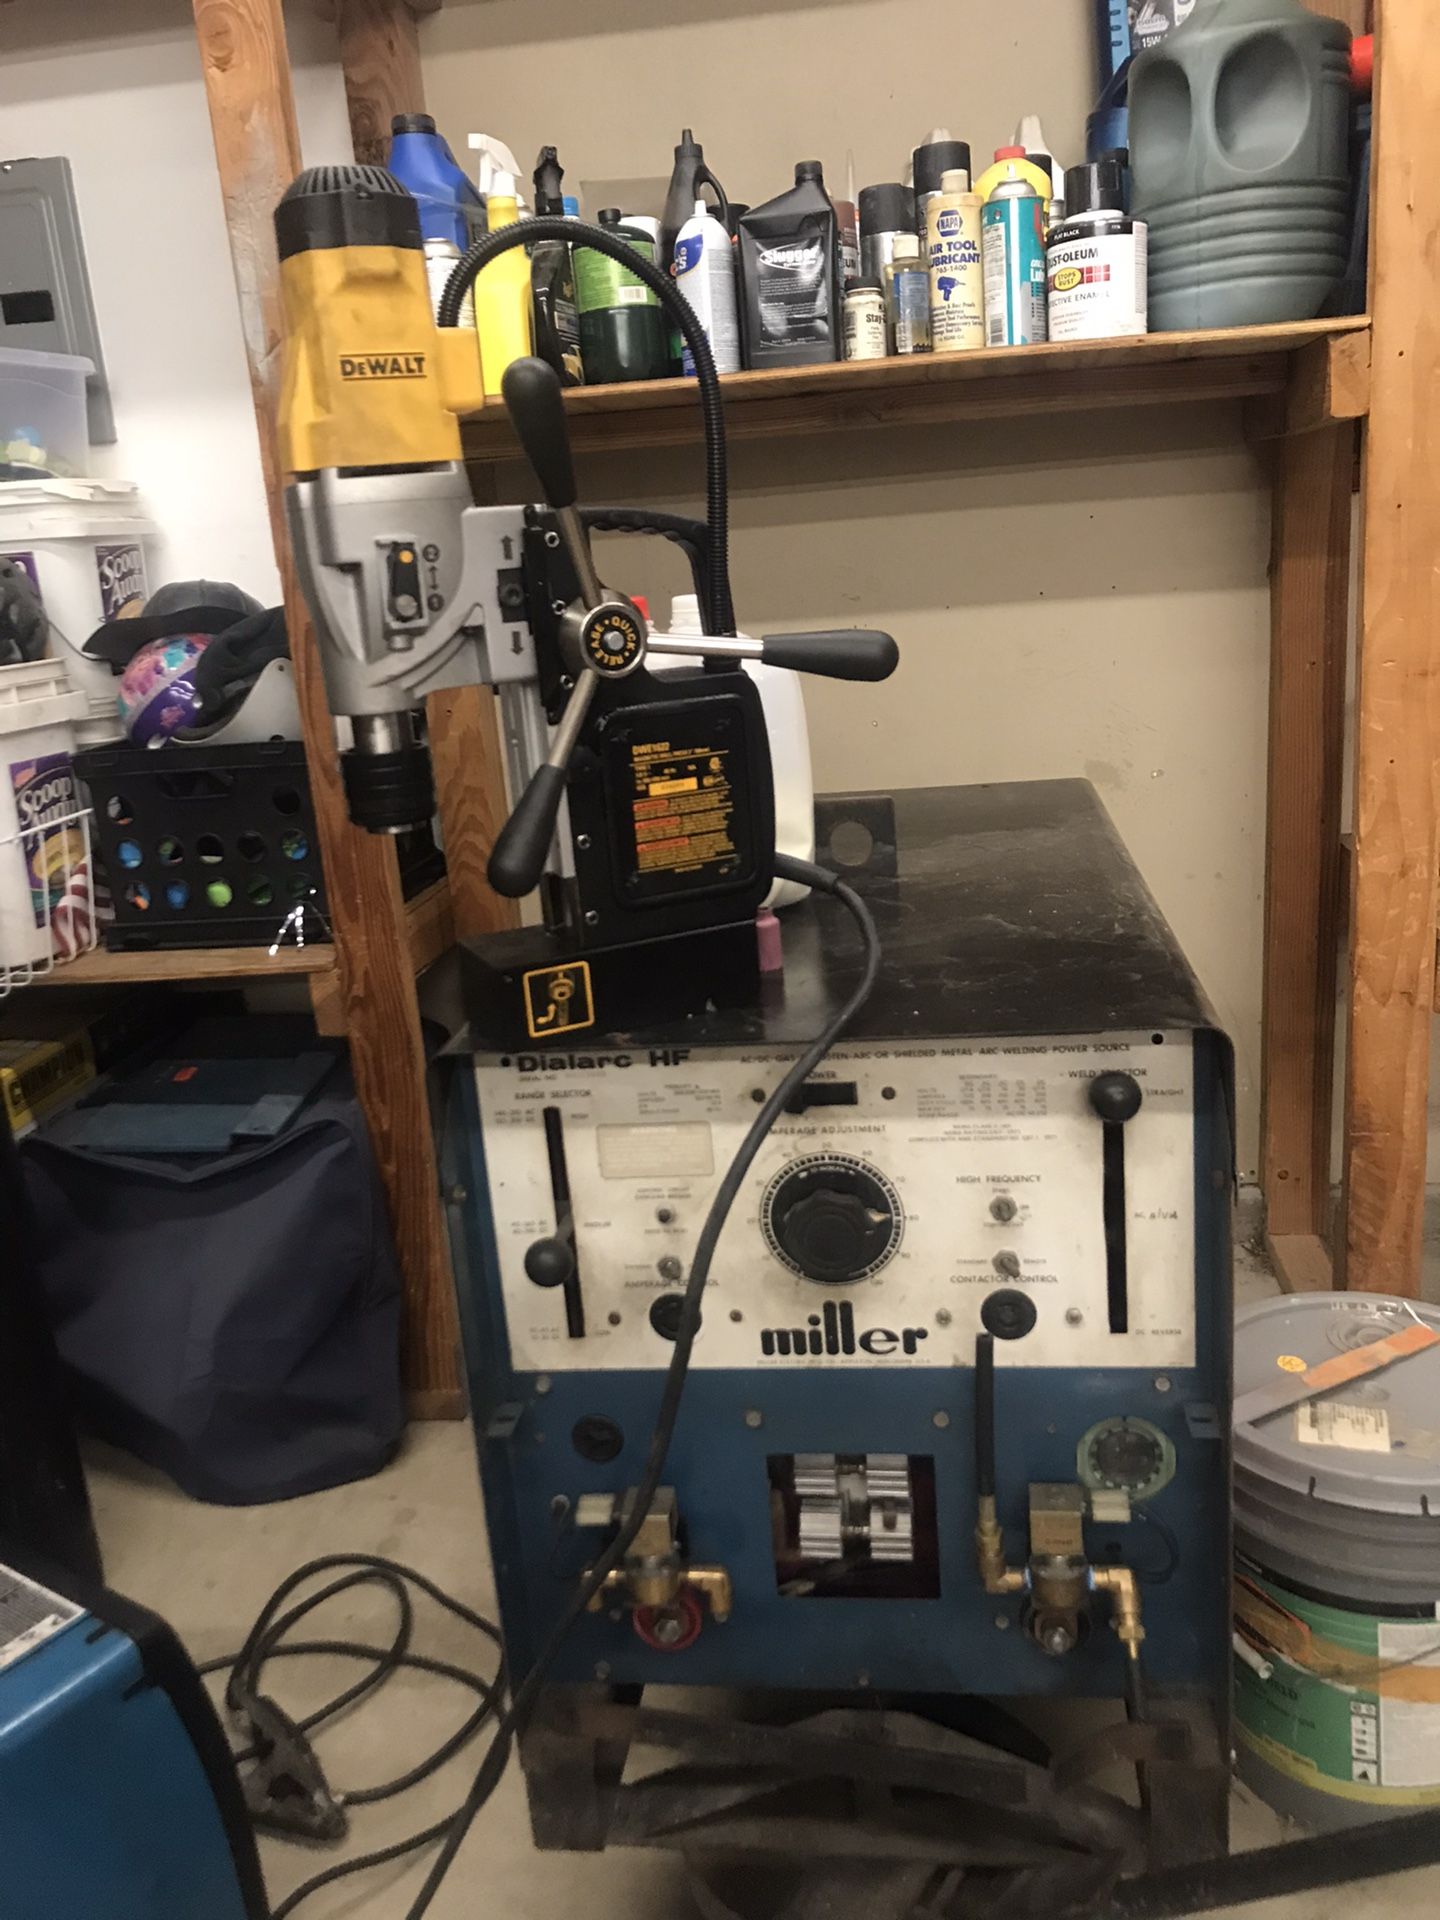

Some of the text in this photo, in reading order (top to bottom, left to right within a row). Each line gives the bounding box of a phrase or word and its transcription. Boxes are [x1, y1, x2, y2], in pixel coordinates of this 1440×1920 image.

[940, 217, 959, 229] NAPA
[1064, 229, 1080, 238] BLACK
[946, 240, 977, 252] TOOL
[930, 252, 980, 268] UBRICANT
[1058, 271, 1076, 279] STOPS
[1058, 278, 1074, 287] RUST
[19, 776, 72, 826] Scoop
[894, 1050, 936, 1058] SHIELDED
[941, 1047, 972, 1056] METAL
[979, 1047, 998, 1056] ARC
[1003, 1046, 1047, 1055] WELDING
[1052, 1044, 1087, 1053] POWER
[1092, 1043, 1130, 1052] SOURCE
[518, 1050, 690, 1073] Dialarc HF
[807, 1071, 836, 1079] OWER
[1068, 1070, 1096, 1079] WELD
[551, 1089, 591, 1099] SELECTOR
[769, 1125, 886, 1135] MPERAGE ADJUSTMENT
[955, 1175, 1041, 1184] HIGH FREQUENCY
[950, 1275, 1058, 1284] CONTACTOR CONTROL
[761, 1300, 928, 1356] miller
